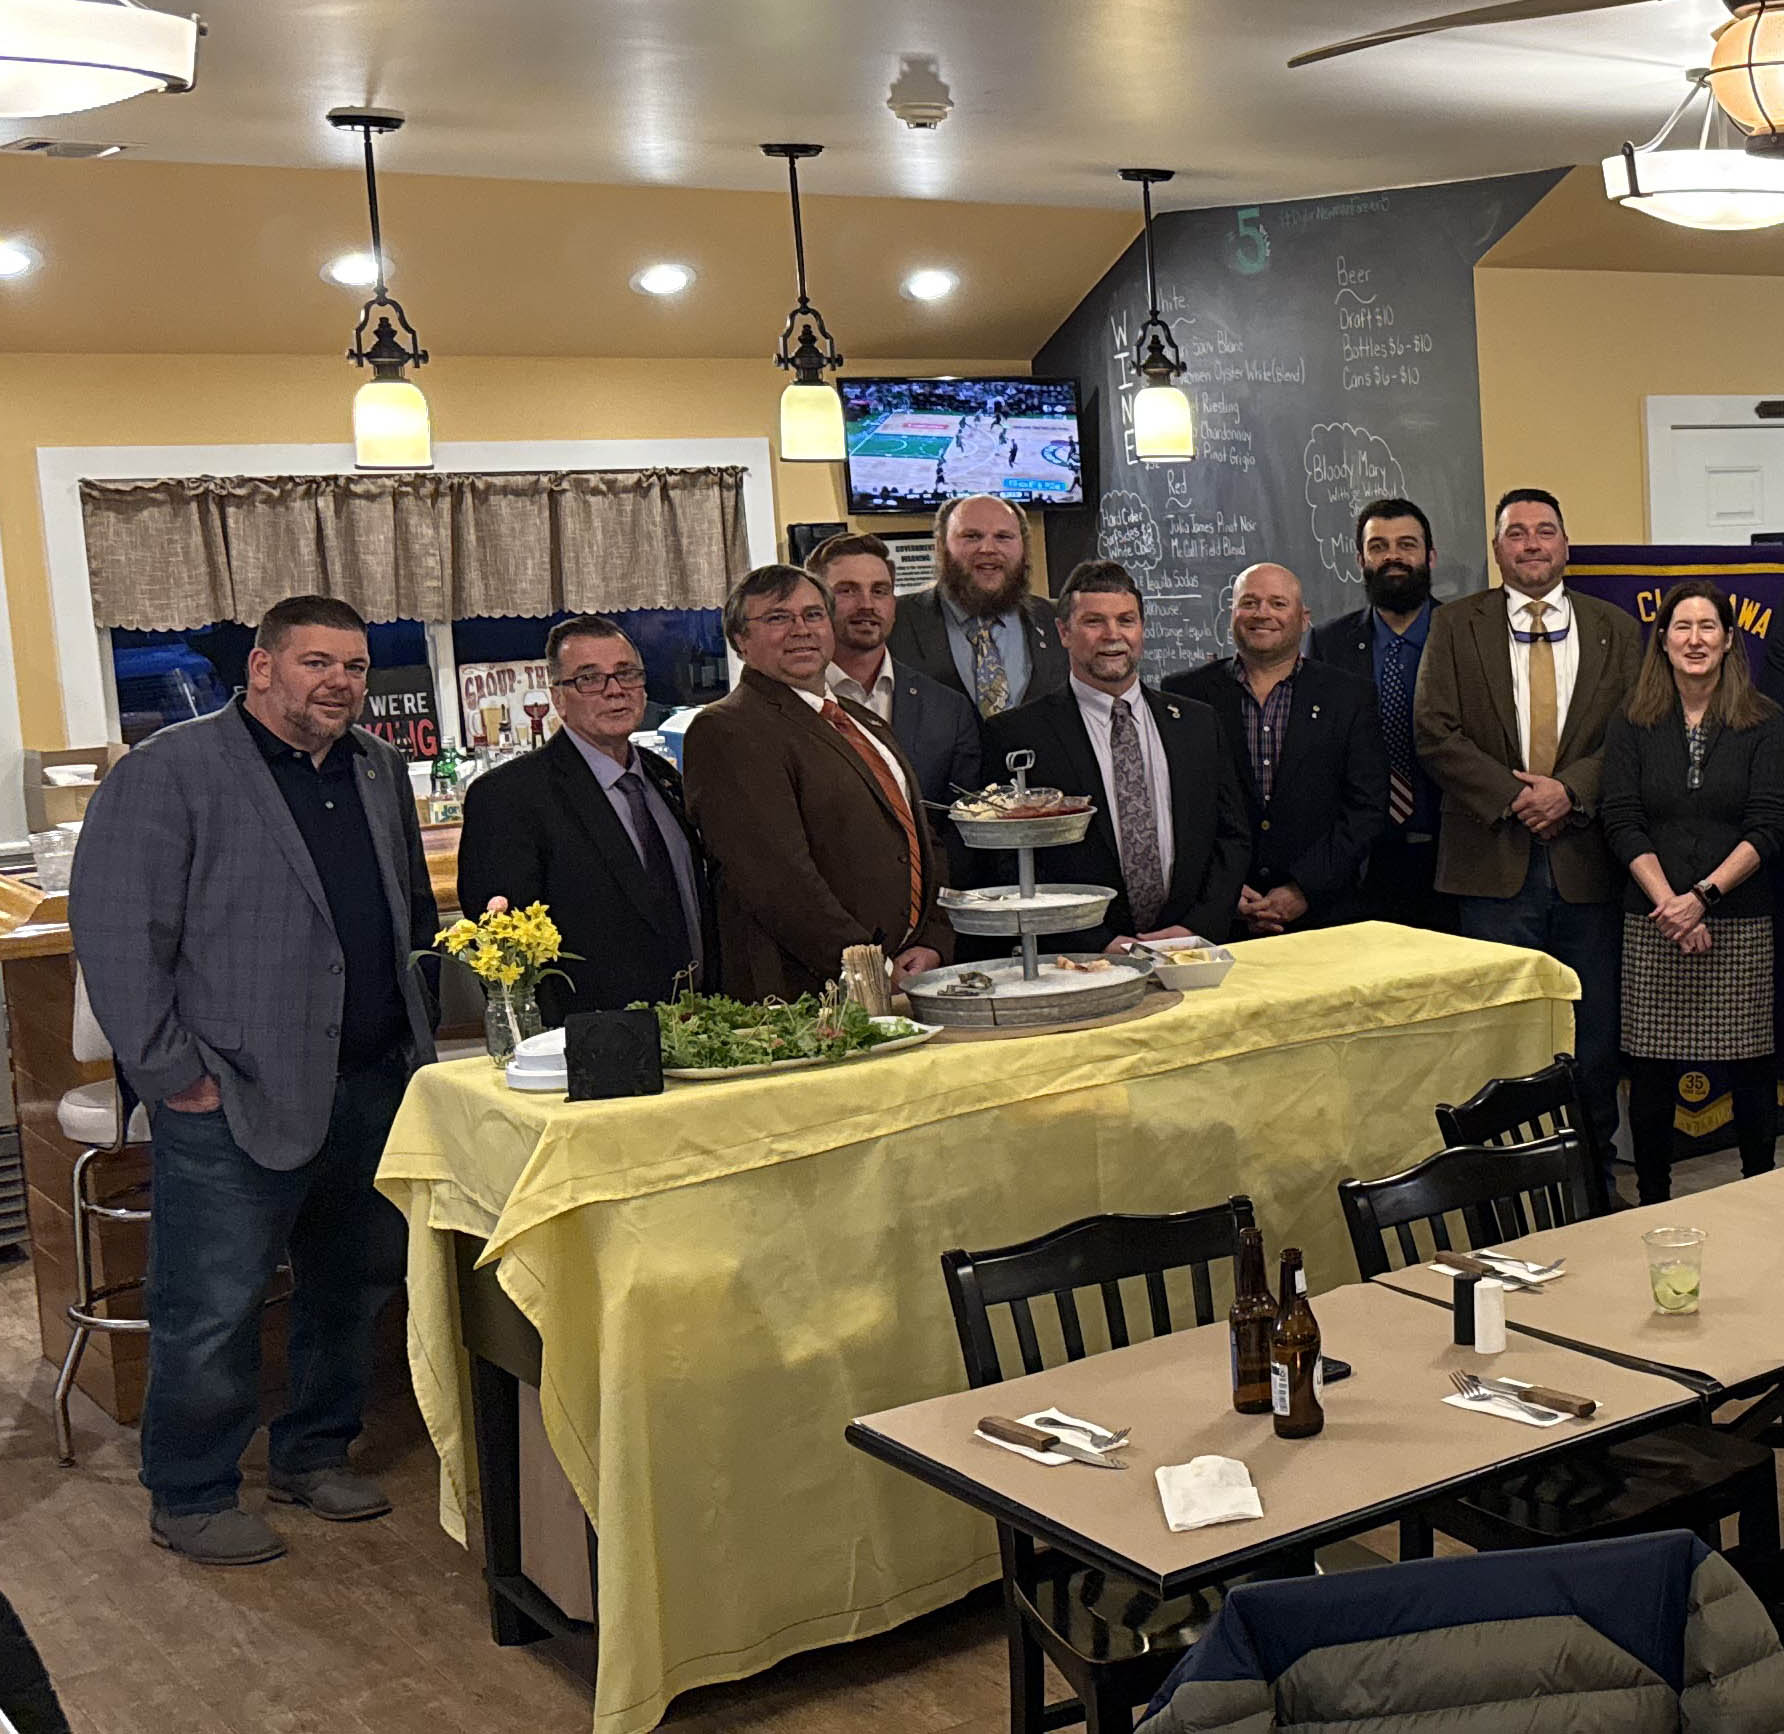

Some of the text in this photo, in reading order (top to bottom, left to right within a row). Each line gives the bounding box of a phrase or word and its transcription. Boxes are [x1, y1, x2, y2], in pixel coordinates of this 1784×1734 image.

[1237, 207, 1267, 274] 5
[1337, 255, 1371, 286] Beer
[1339, 304, 1394, 331] Draft $10
[1342, 333, 1387, 362] Bottles
[1342, 365, 1372, 390] Cans
[1202, 392, 1240, 425] Riesling
[1200, 420, 1251, 450] Chardonnay
[1203, 441, 1257, 473] Pinot Grigio
[1313, 448, 1386, 489] Bloody Mary
[1167, 468, 1188, 495] Red
[1327, 486, 1350, 503] With
[1361, 480, 1396, 497] Without
[1101, 506, 1143, 528] Hard Cider
[1216, 511, 1238, 533] Pinot
[1239, 514, 1257, 533] Noir
[1144, 568, 1173, 597] Tequila
[1173, 567, 1199, 589] Sodas
[368, 692, 430, 717] WE'RE
[1685, 1074, 1704, 1090] 35
